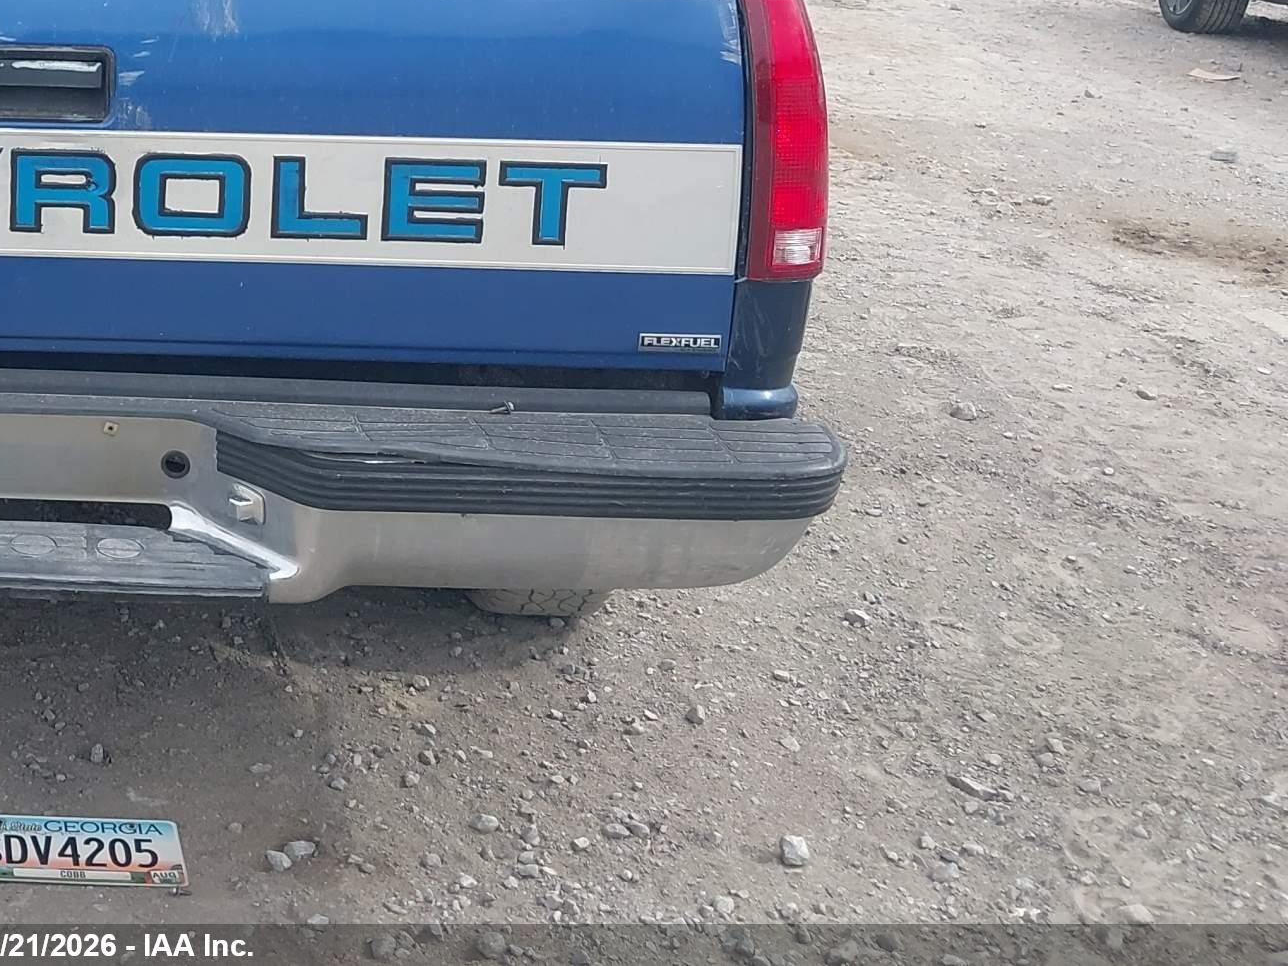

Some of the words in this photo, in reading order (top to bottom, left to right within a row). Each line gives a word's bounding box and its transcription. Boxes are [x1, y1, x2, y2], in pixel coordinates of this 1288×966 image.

[643, 337, 719, 348] FLEXFUEL
[44, 819, 163, 836] GEORGIA
[60, 870, 86, 879] COBB
